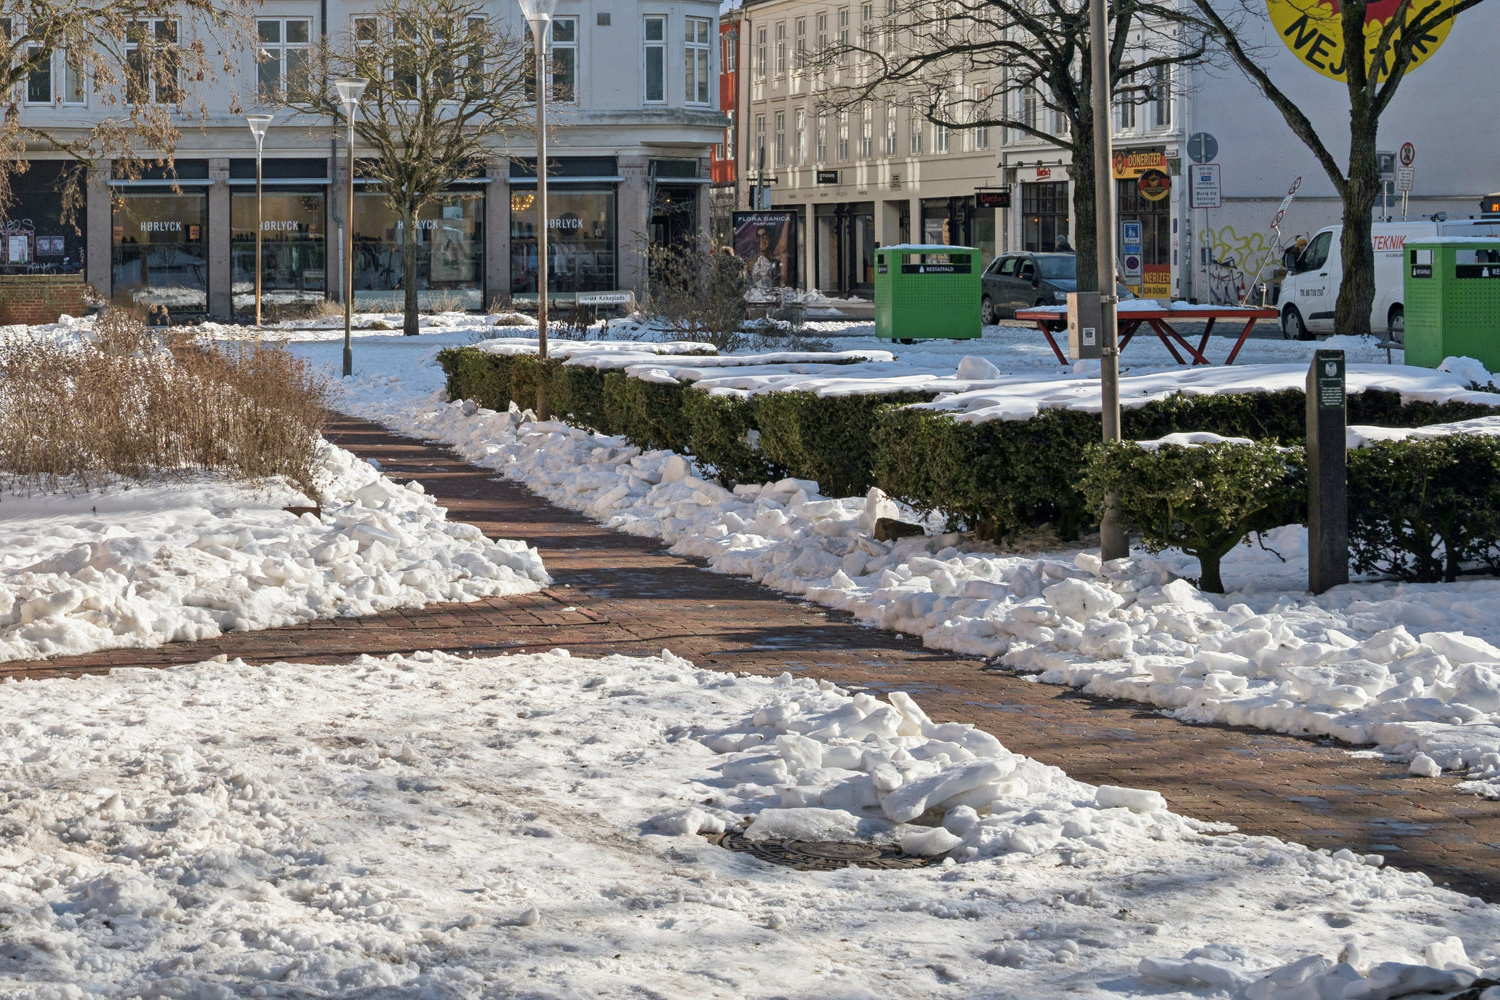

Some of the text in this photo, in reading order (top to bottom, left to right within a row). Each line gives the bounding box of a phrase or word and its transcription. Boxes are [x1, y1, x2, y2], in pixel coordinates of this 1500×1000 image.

[1284, 16, 1346, 75] NEJ
[140, 221, 182, 232] HØRLYCK
[397, 219, 439, 230] HLYCK
[546, 218, 584, 229] ØRLYCK
[1372, 235, 1407, 250] TEKNIK
[1144, 272, 1171, 283] NERIZER
